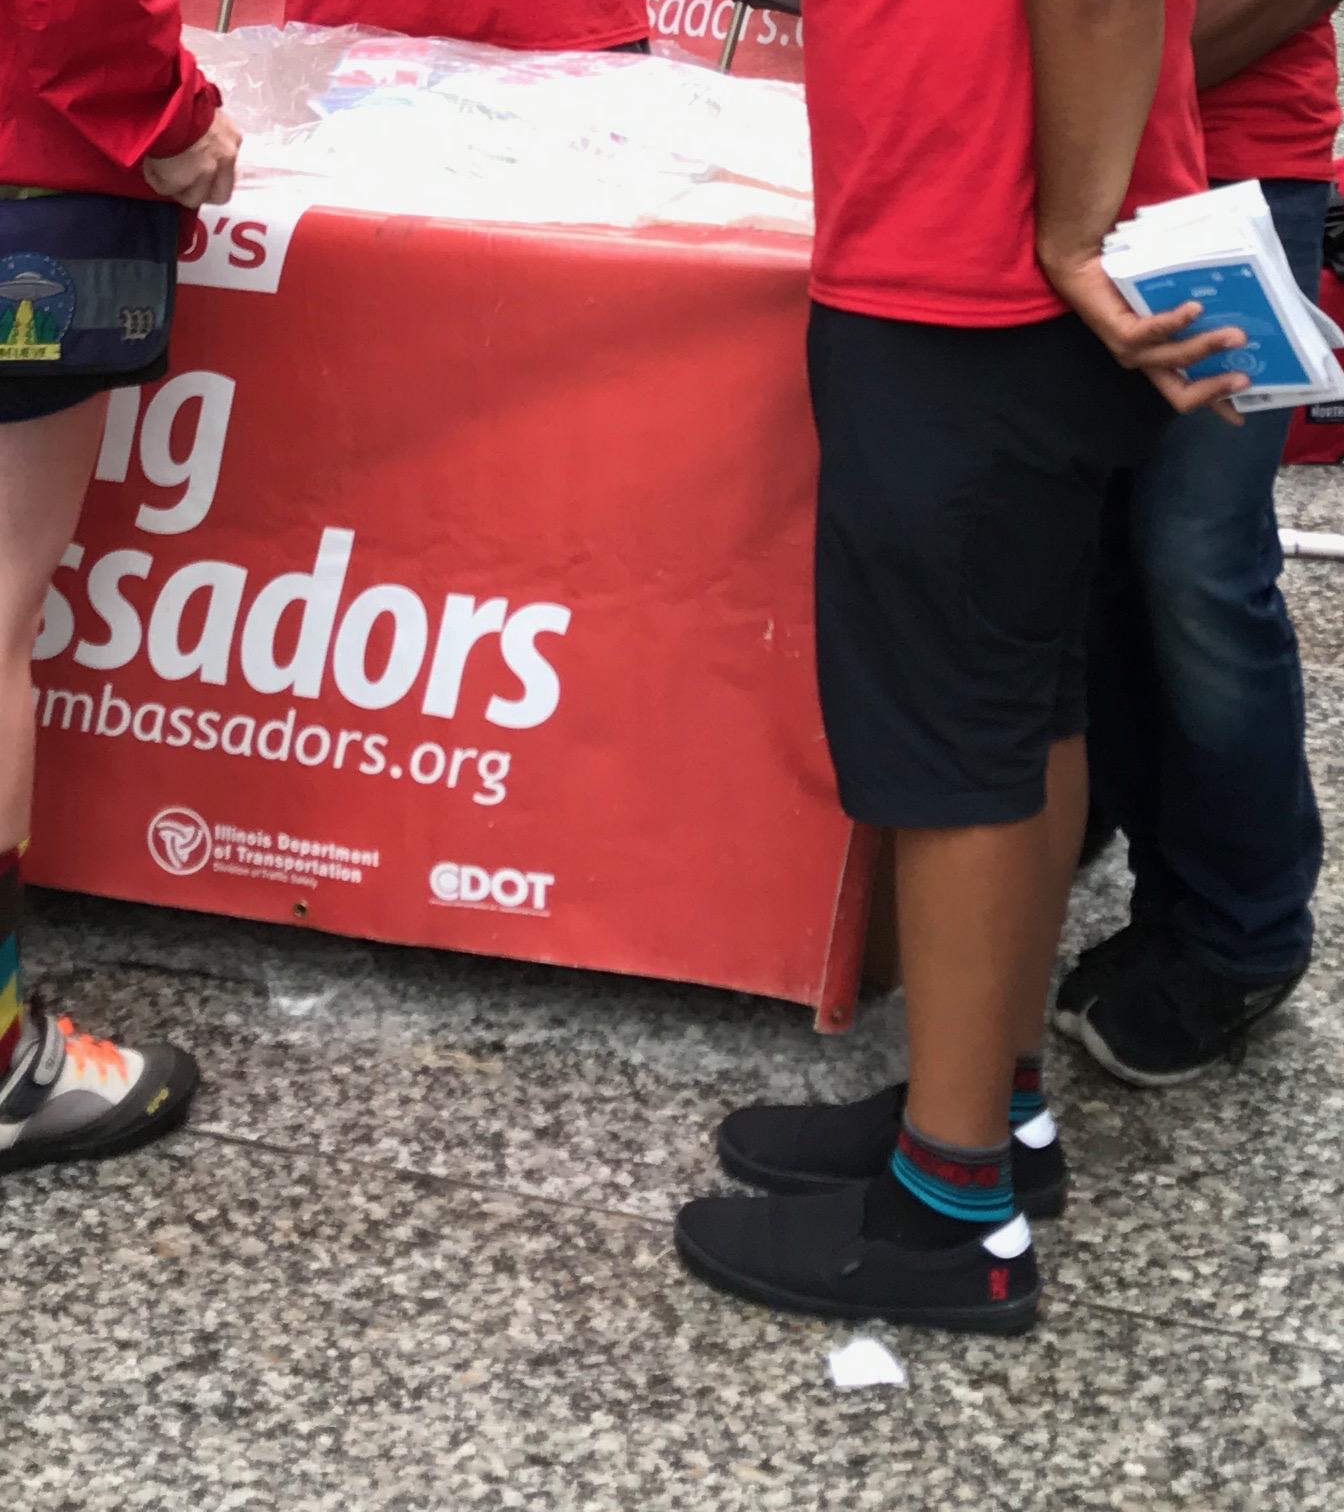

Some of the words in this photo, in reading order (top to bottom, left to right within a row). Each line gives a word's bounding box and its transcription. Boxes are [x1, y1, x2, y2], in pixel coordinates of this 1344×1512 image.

[214, 823, 272, 849] Illinois
[276, 831, 380, 868] Department
[214, 844, 232, 860] of
[236, 845, 362, 884] Transportation
[429, 861, 555, 909] CDOT
